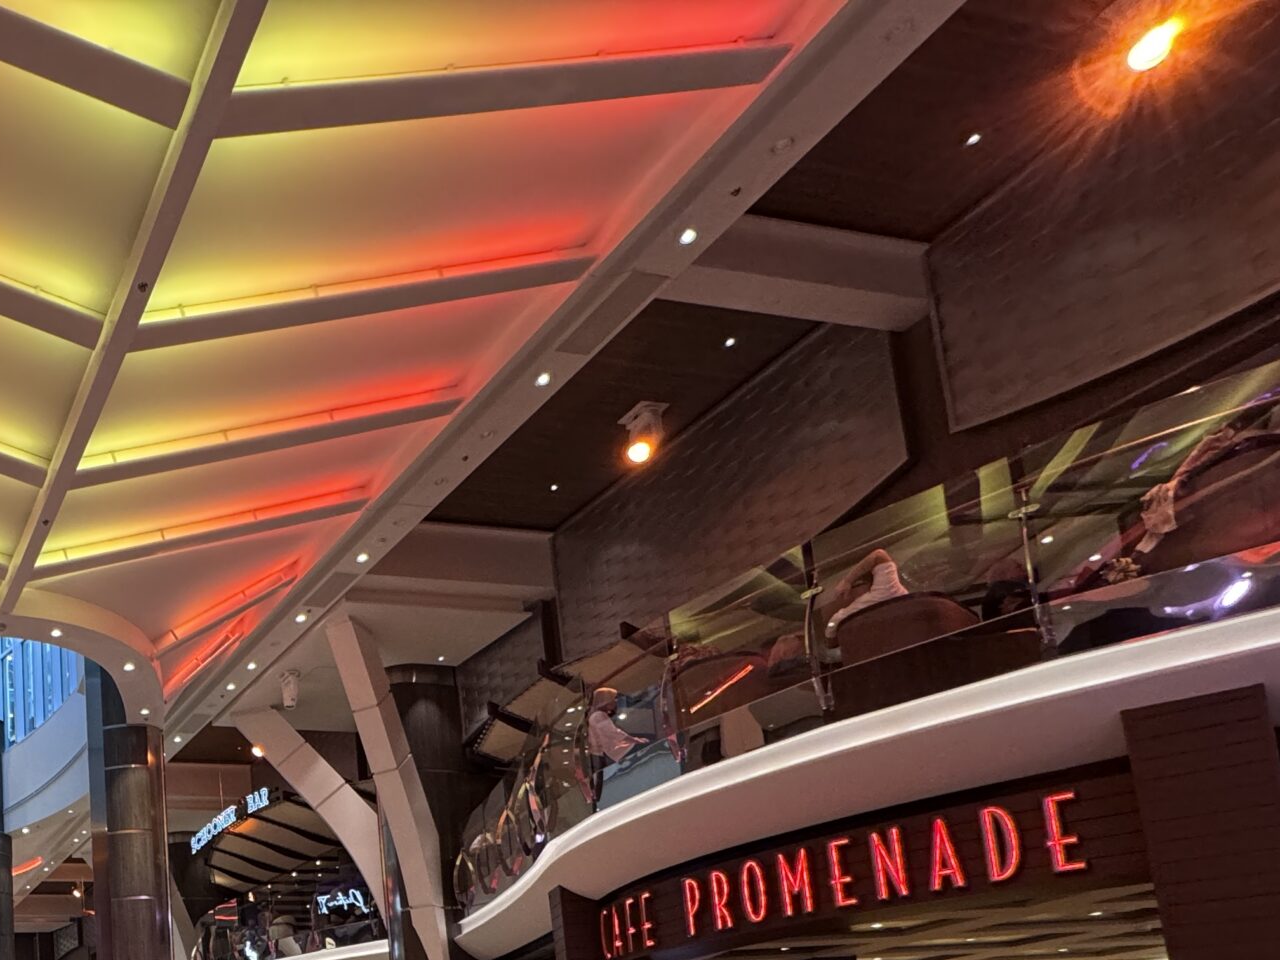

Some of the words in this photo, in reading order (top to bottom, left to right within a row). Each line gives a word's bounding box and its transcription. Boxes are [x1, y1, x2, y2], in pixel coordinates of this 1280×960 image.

[245, 787, 270, 814] BAR
[600, 892, 655, 960] CAFE
[681, 789, 1088, 937] PROMENADE
